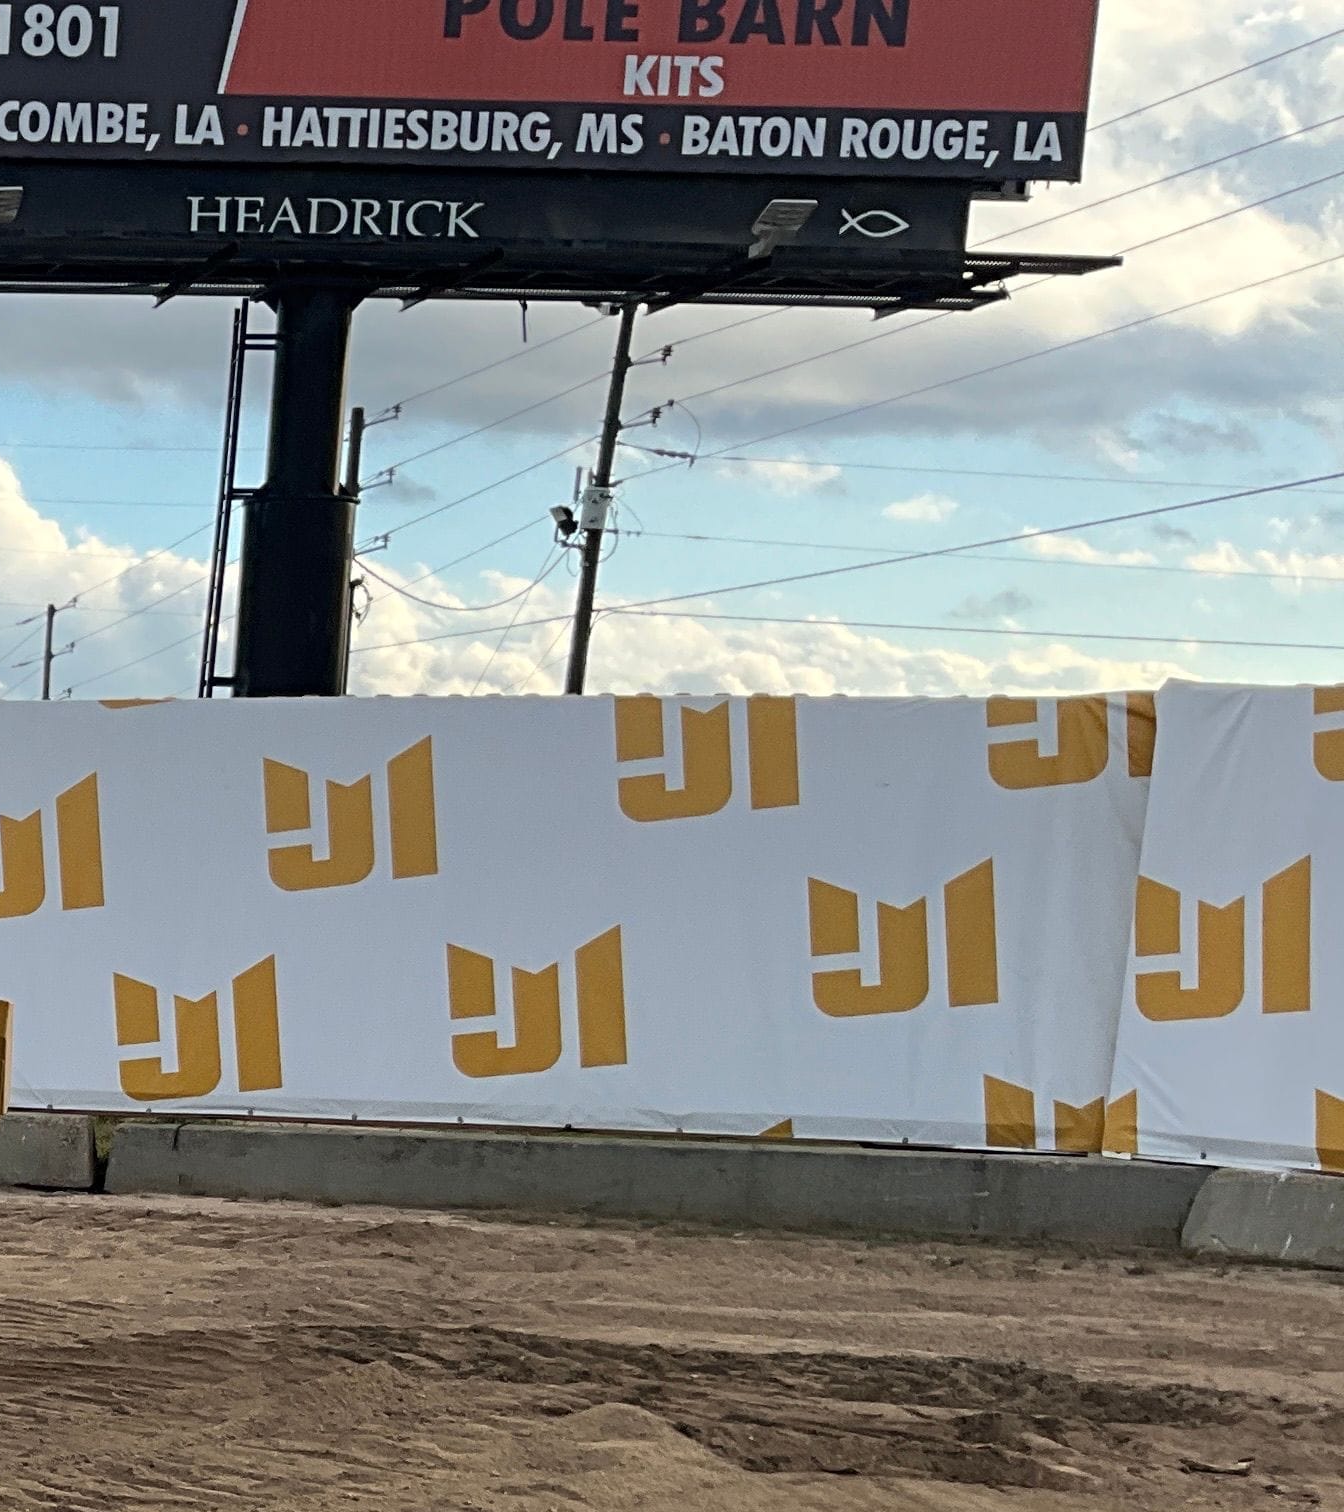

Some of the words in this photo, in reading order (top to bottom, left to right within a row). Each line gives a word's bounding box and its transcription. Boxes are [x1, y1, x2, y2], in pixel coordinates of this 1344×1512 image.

[443, 0, 640, 42] POLE
[678, 0, 910, 47] BARN
[623, 54, 725, 97] KITS
[174, 104, 225, 146] LA
[262, 106, 563, 160] HATTIESBURG,
[575, 112, 644, 154] MS
[681, 115, 826, 158] BATON
[839, 117, 1000, 168] ROUGE,
[1013, 121, 1063, 163] LA
[186, 196, 484, 239] HEADRICK
